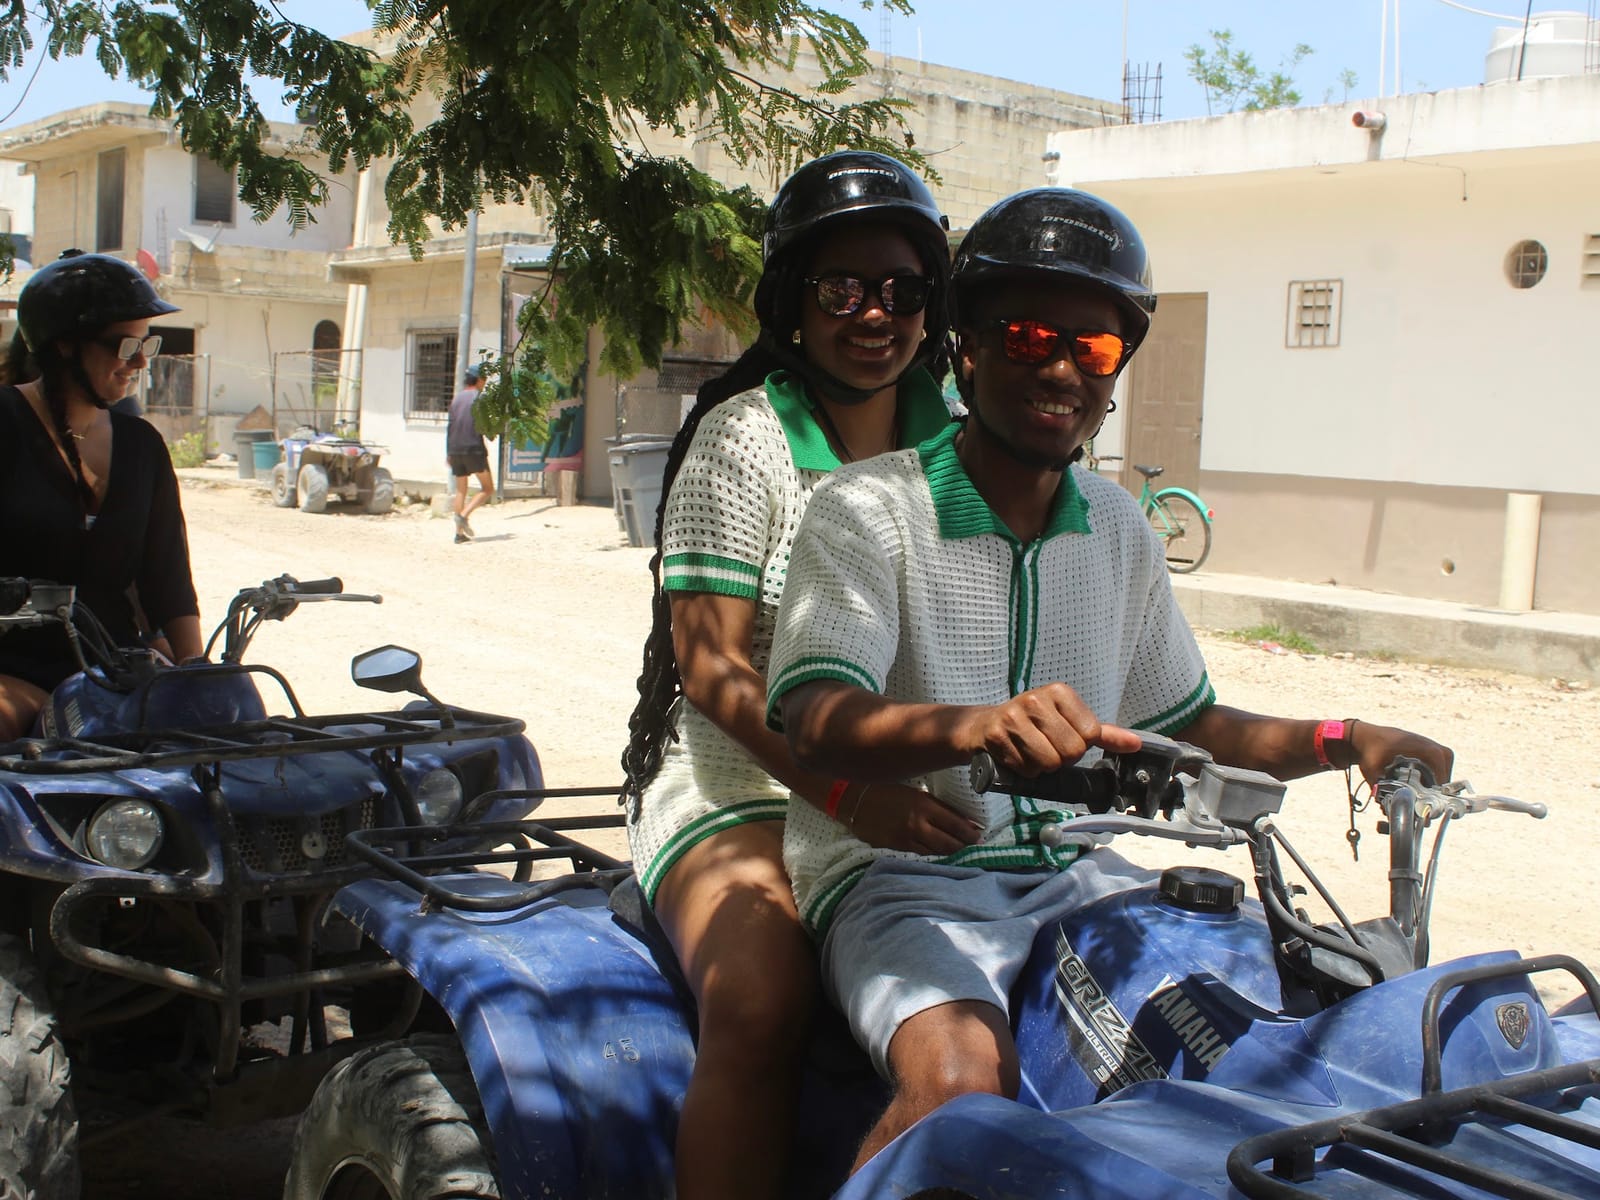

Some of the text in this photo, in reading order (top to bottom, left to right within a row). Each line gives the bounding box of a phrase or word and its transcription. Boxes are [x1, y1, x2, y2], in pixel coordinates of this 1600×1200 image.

[1042, 215, 1115, 243] promoto
[1148, 973, 1231, 1073] YAMAHA
[603, 1038, 640, 1064] 45
